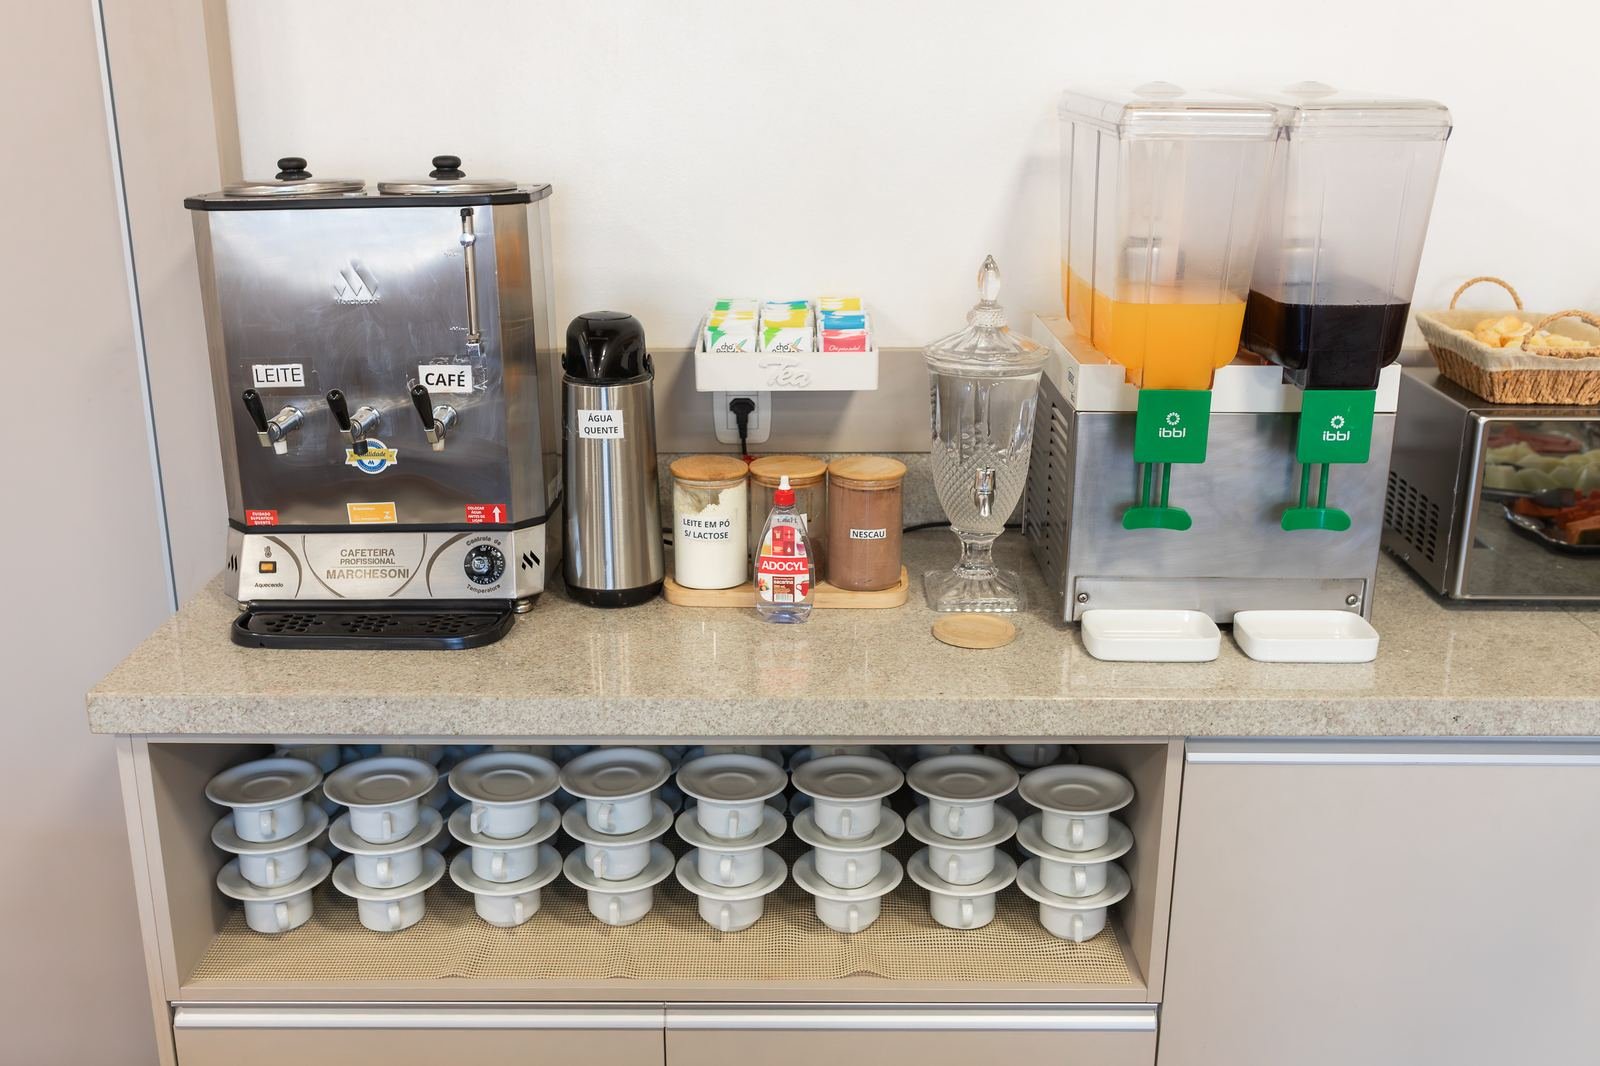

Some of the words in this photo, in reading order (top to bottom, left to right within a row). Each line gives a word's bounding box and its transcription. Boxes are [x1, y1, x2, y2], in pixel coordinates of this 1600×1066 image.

[255, 367, 302, 383] LEITE
[425, 370, 466, 387] CAFÉ
[587, 413, 613, 422] ÁGUA
[583, 426, 619, 435] QUENTE
[1158, 427, 1187, 438] ibbl
[1322, 430, 1351, 441] ibbl
[683, 518, 702, 528] LEITE
[719, 518, 730, 528] PÓ
[684, 529, 691, 537] S/
[692, 531, 729, 540] LACTOSE
[852, 530, 885, 538] NESCAU
[340, 548, 396, 557] CAFETEIRA
[339, 557, 396, 565] PROFISSIONAL
[761, 560, 808, 571] ADOCYL
[326, 568, 410, 580] MARCHESONI
